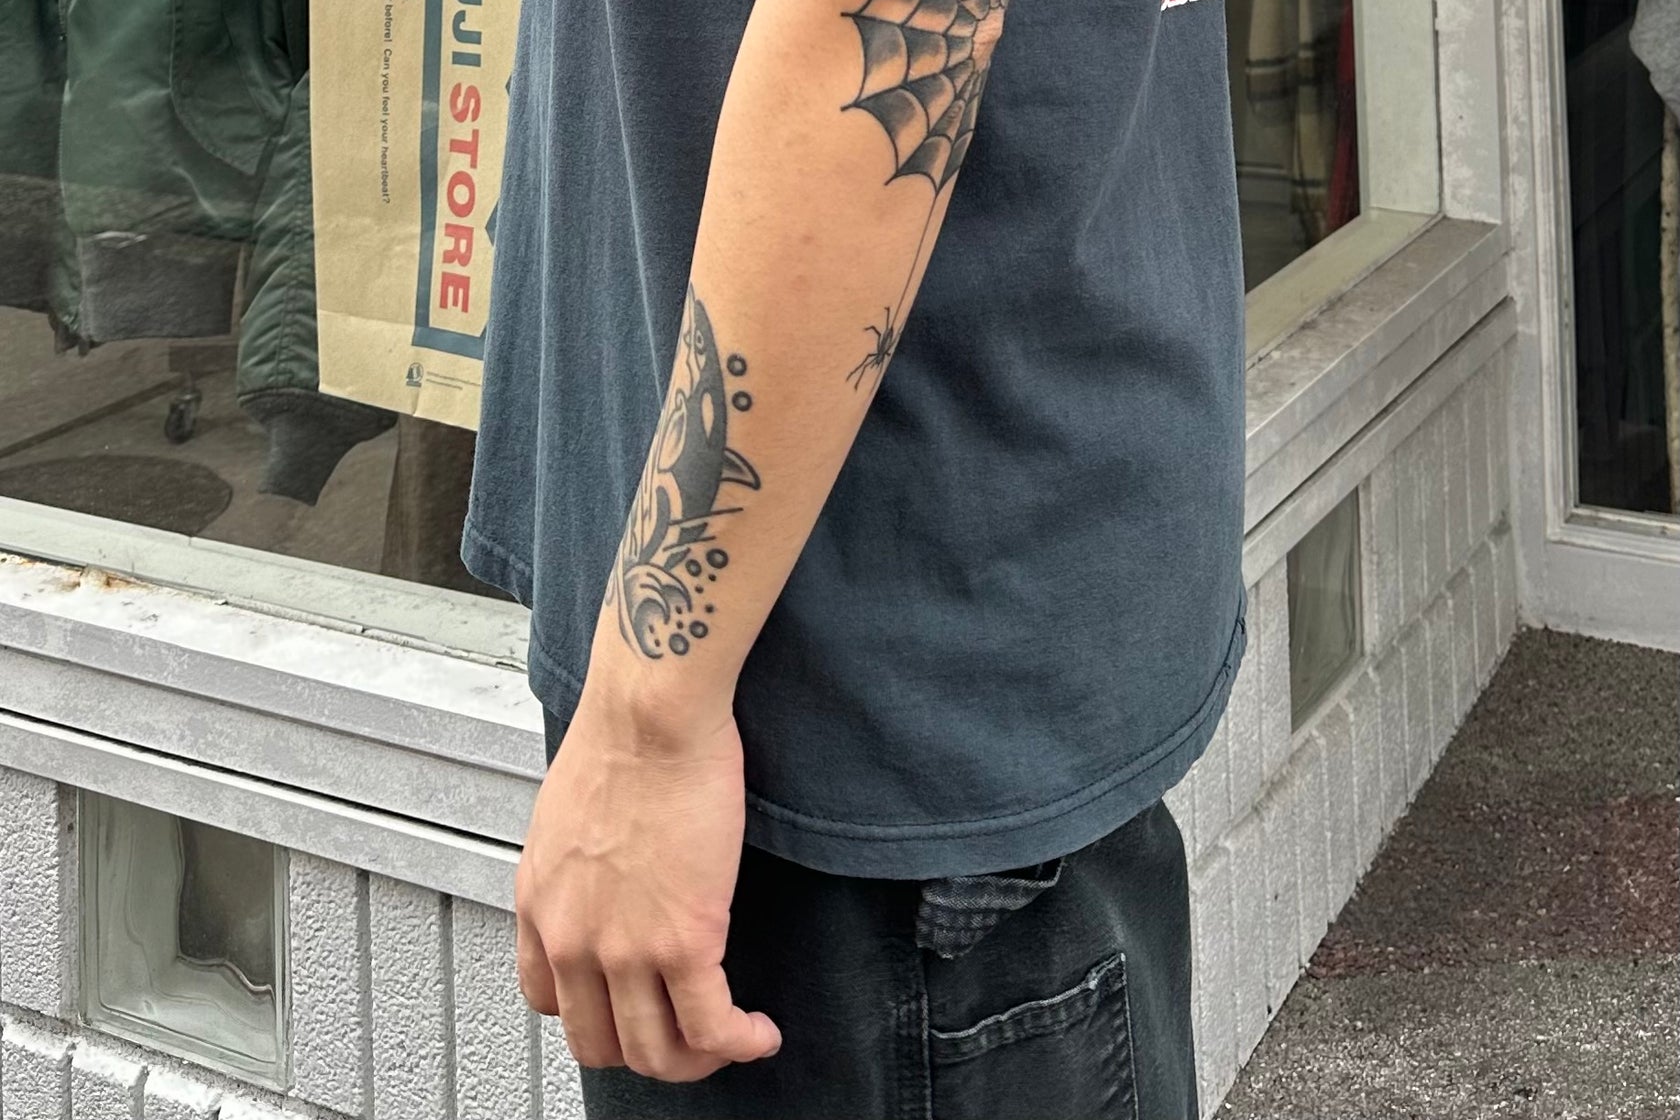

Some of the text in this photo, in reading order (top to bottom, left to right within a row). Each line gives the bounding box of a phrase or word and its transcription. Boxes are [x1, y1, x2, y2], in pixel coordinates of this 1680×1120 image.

[384, 4, 394, 42] before!
[383, 49, 392, 69] Can
[381, 73, 389, 93] you
[382, 96, 390, 115] feel
[380, 119, 388, 143] your
[381, 147, 390, 203] heartbeat?
[439, 82, 481, 313] STORE
